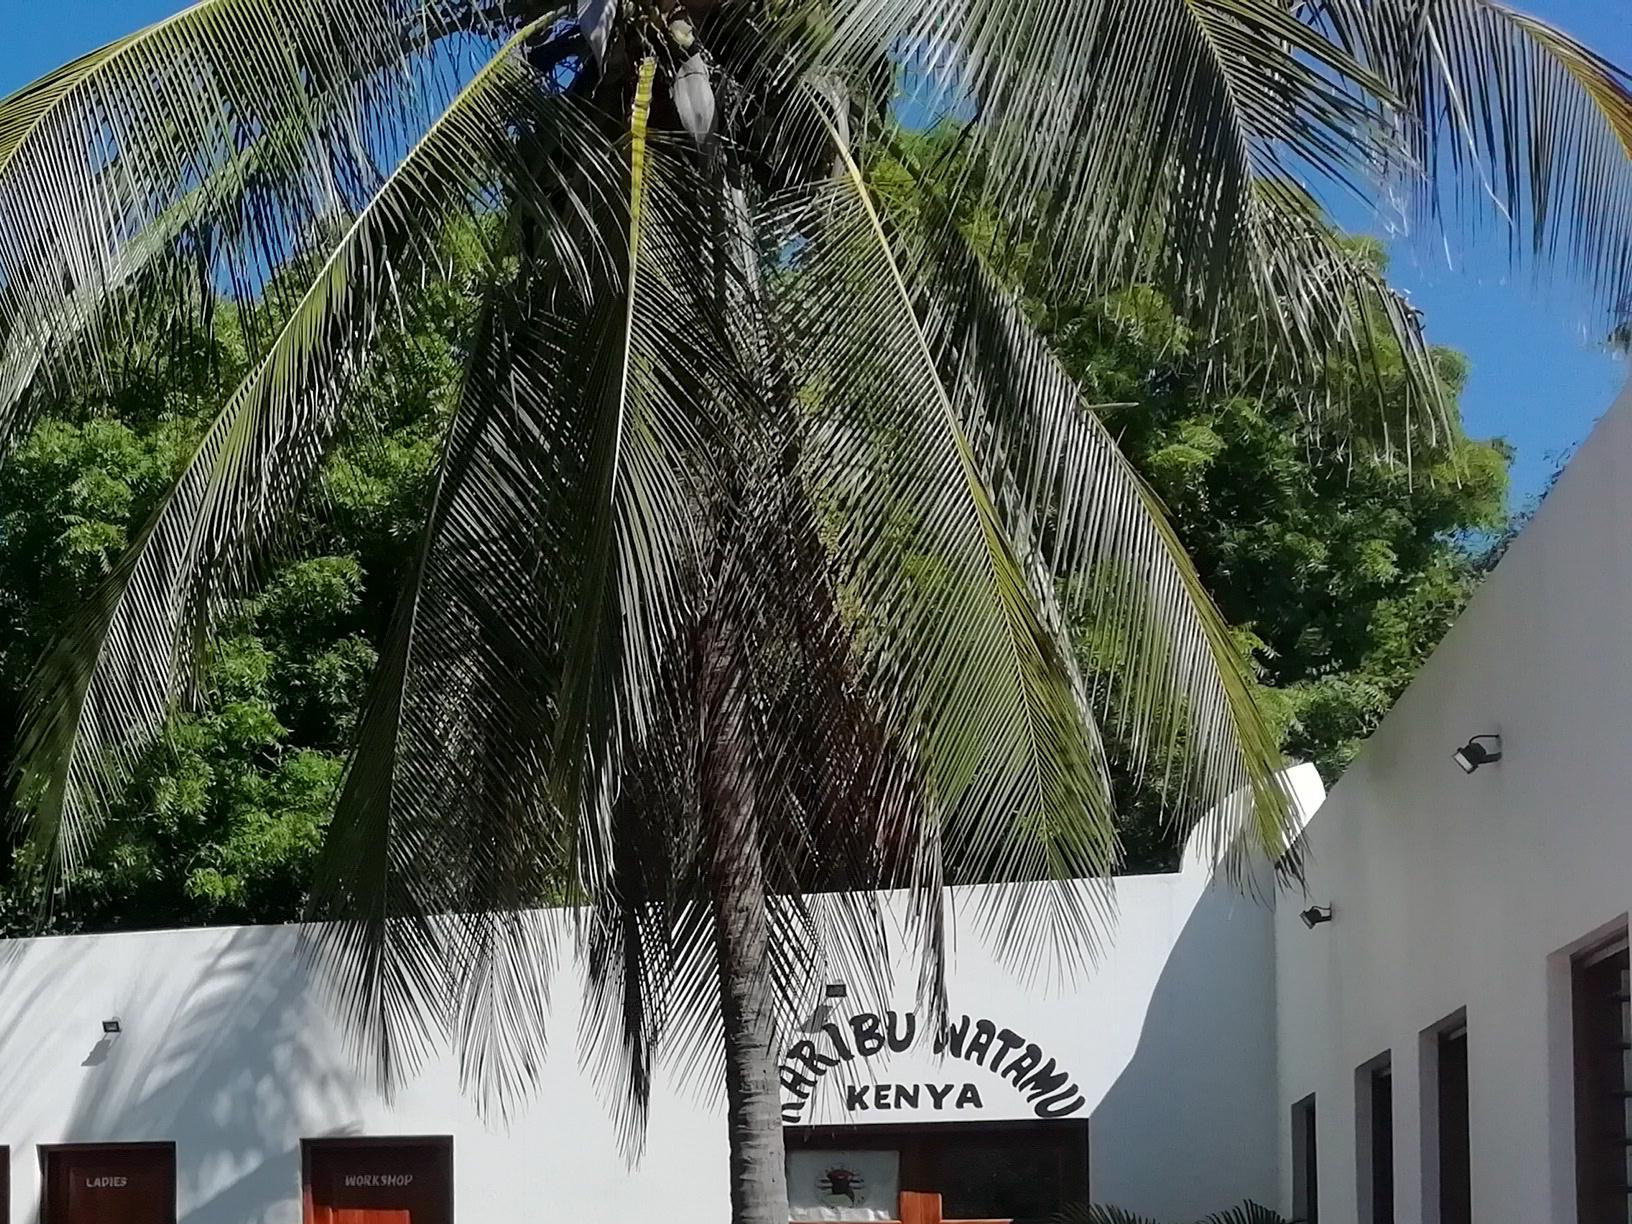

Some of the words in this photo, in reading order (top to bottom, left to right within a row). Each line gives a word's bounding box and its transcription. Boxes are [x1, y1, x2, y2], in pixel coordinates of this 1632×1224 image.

[933, 1014, 1086, 1118] WATAMU
[846, 1084, 983, 1111] KENYA
[86, 1177, 128, 1188] LADIES
[344, 1174, 413, 1187] WORKSHOP
